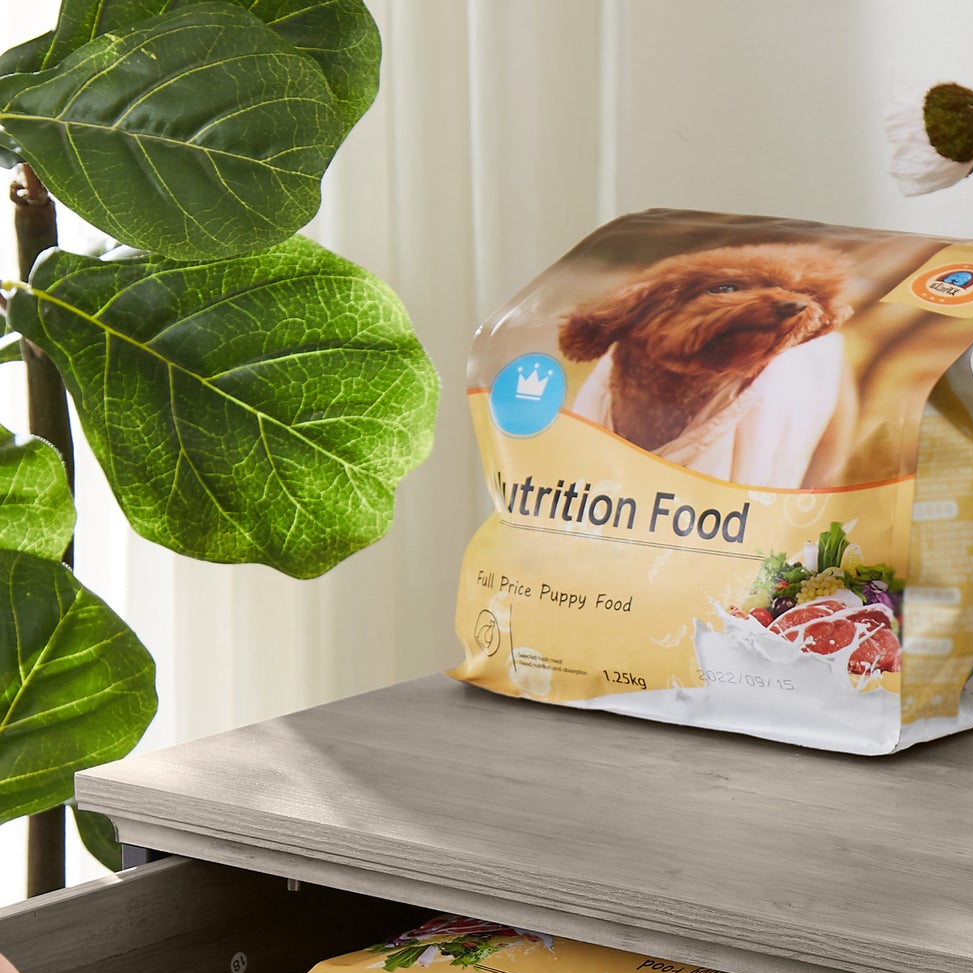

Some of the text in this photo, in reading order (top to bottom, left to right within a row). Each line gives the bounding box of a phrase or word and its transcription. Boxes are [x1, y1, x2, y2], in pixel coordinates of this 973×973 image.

[497, 472, 751, 544] utrition Food
[477, 570, 633, 613] Full Price Puppy Food
[603, 669, 648, 690] 1.25kg
